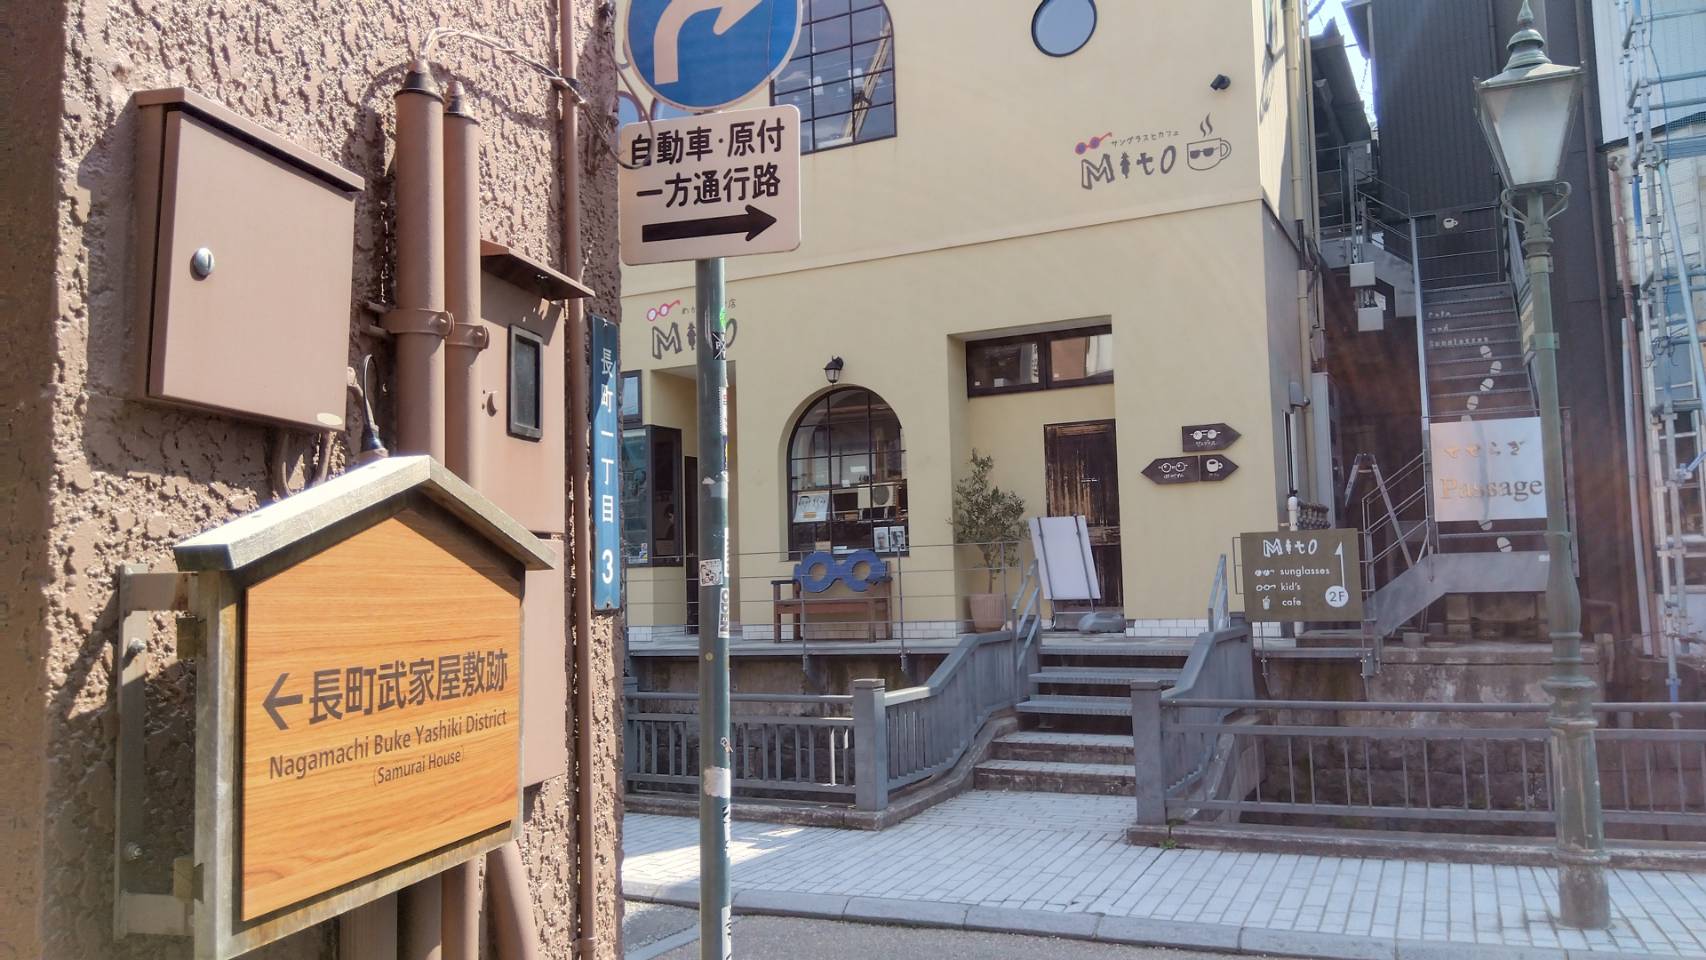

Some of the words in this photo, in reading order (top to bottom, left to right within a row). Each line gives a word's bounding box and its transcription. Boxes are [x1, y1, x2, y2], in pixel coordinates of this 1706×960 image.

[636, 162, 781, 208] 一方通行路
[600, 347, 614, 523] 長町一丁目
[1440, 479, 1543, 502] Passage
[602, 549, 613, 584] 3
[1280, 566, 1330, 577] sunglasses
[1280, 582, 1301, 591] kid's
[1282, 596, 1302, 606] cafe
[1329, 591, 1345, 602] 2F
[309, 648, 508, 725] 長町武家屋敷跡
[269, 735, 369, 780] Nagamachi
[374, 729, 411, 756] Buke
[416, 717, 462, 745] Yashiki
[465, 710, 508, 734] District
[373, 756, 426, 787] (Samurai
[428, 745, 465, 770] House)
